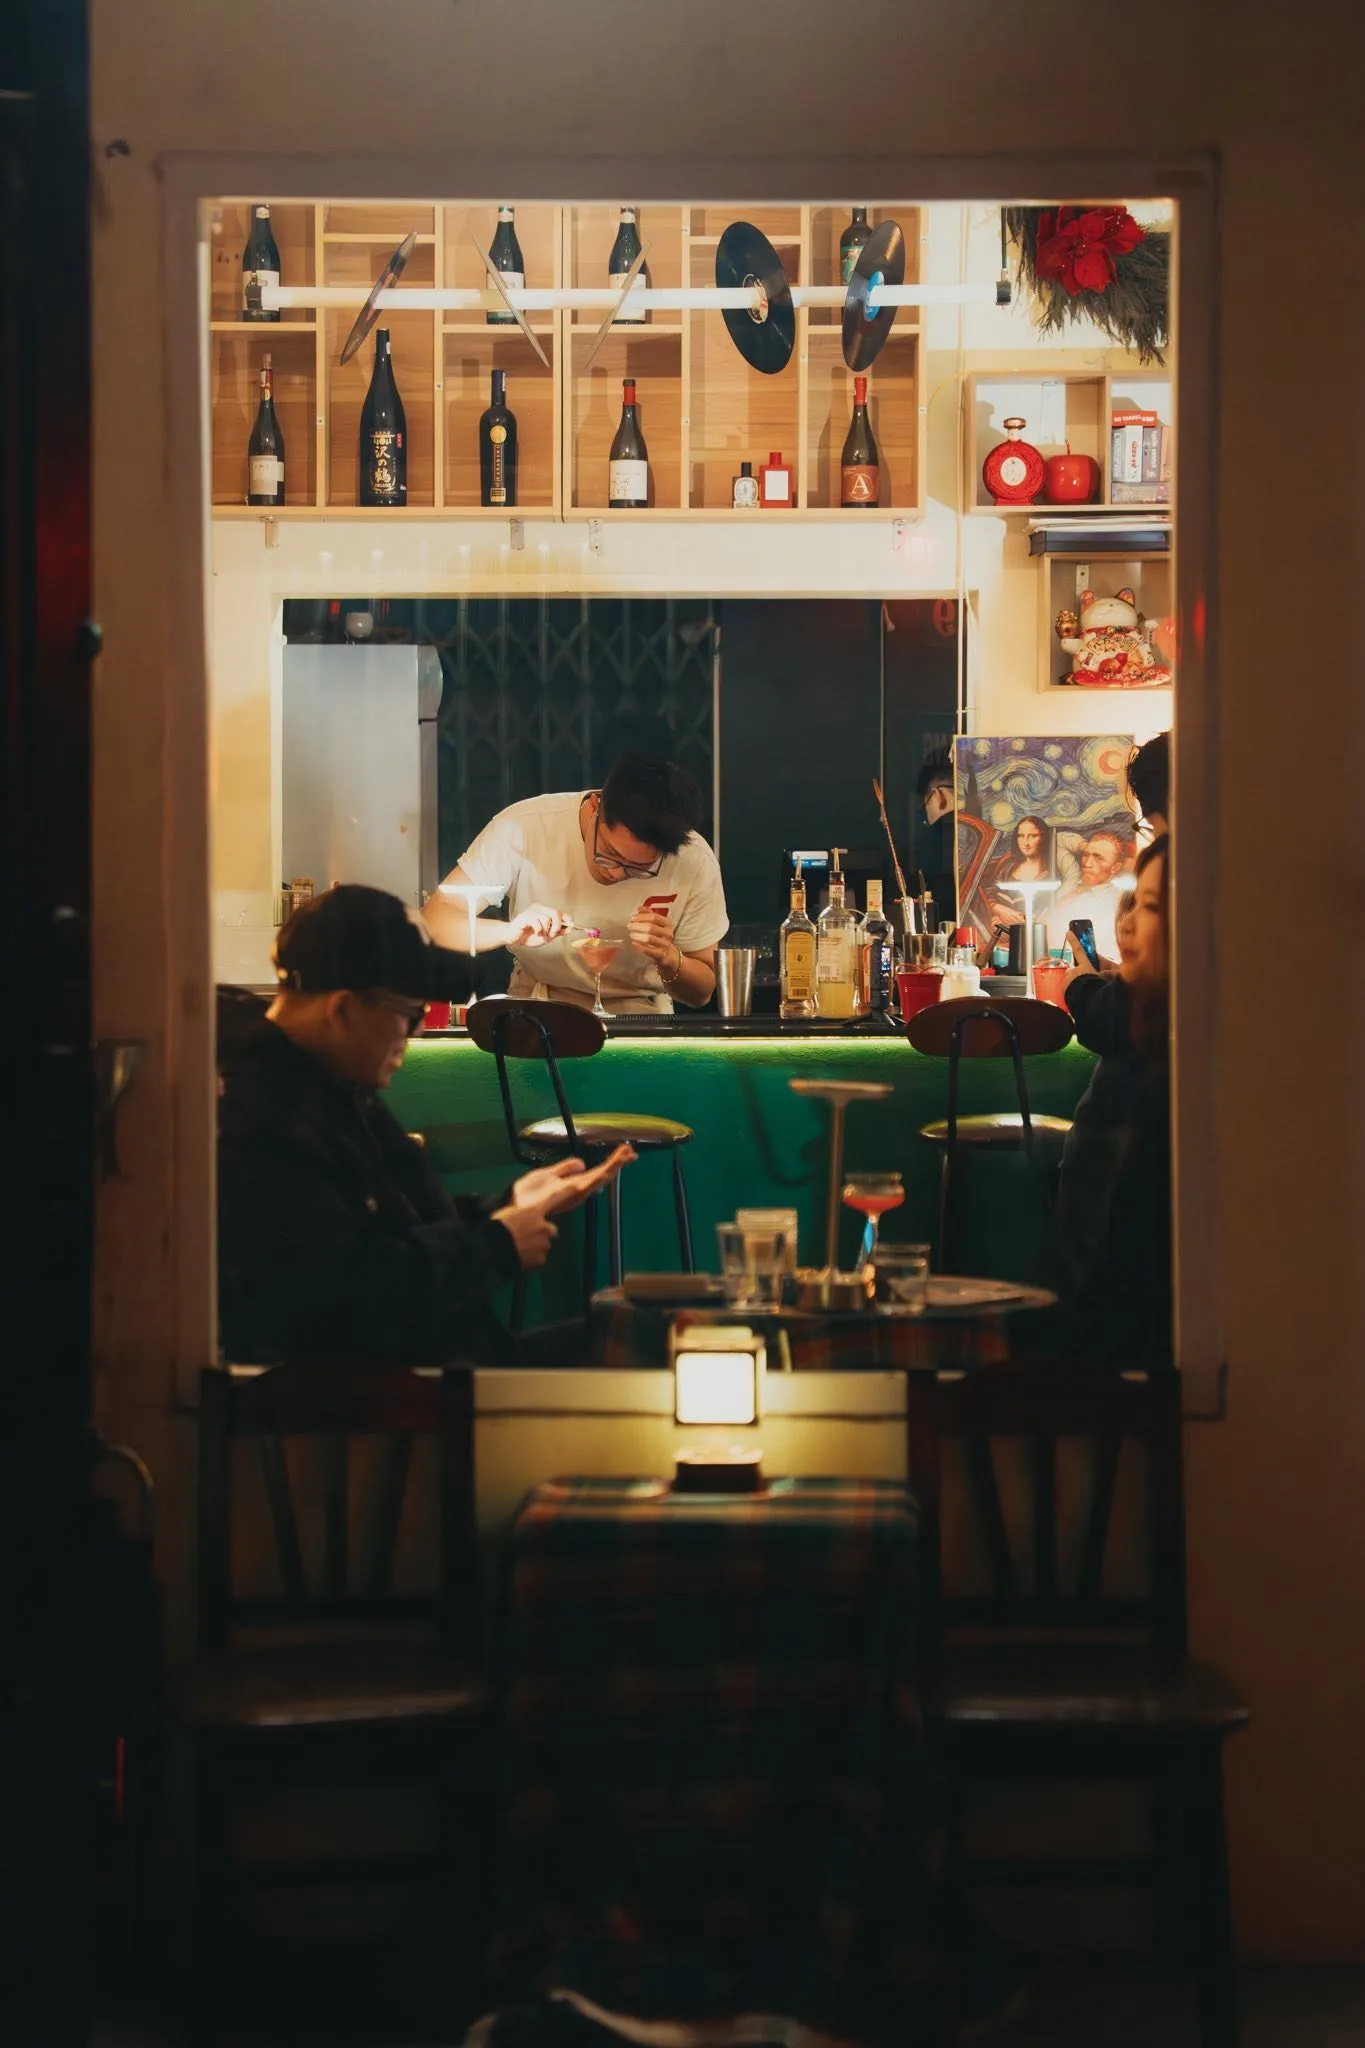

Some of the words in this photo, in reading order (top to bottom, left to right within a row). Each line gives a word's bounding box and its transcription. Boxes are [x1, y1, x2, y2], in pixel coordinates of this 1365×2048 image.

[374, 446, 391, 483] 沢の鶴
[851, 474, 869, 495] A
